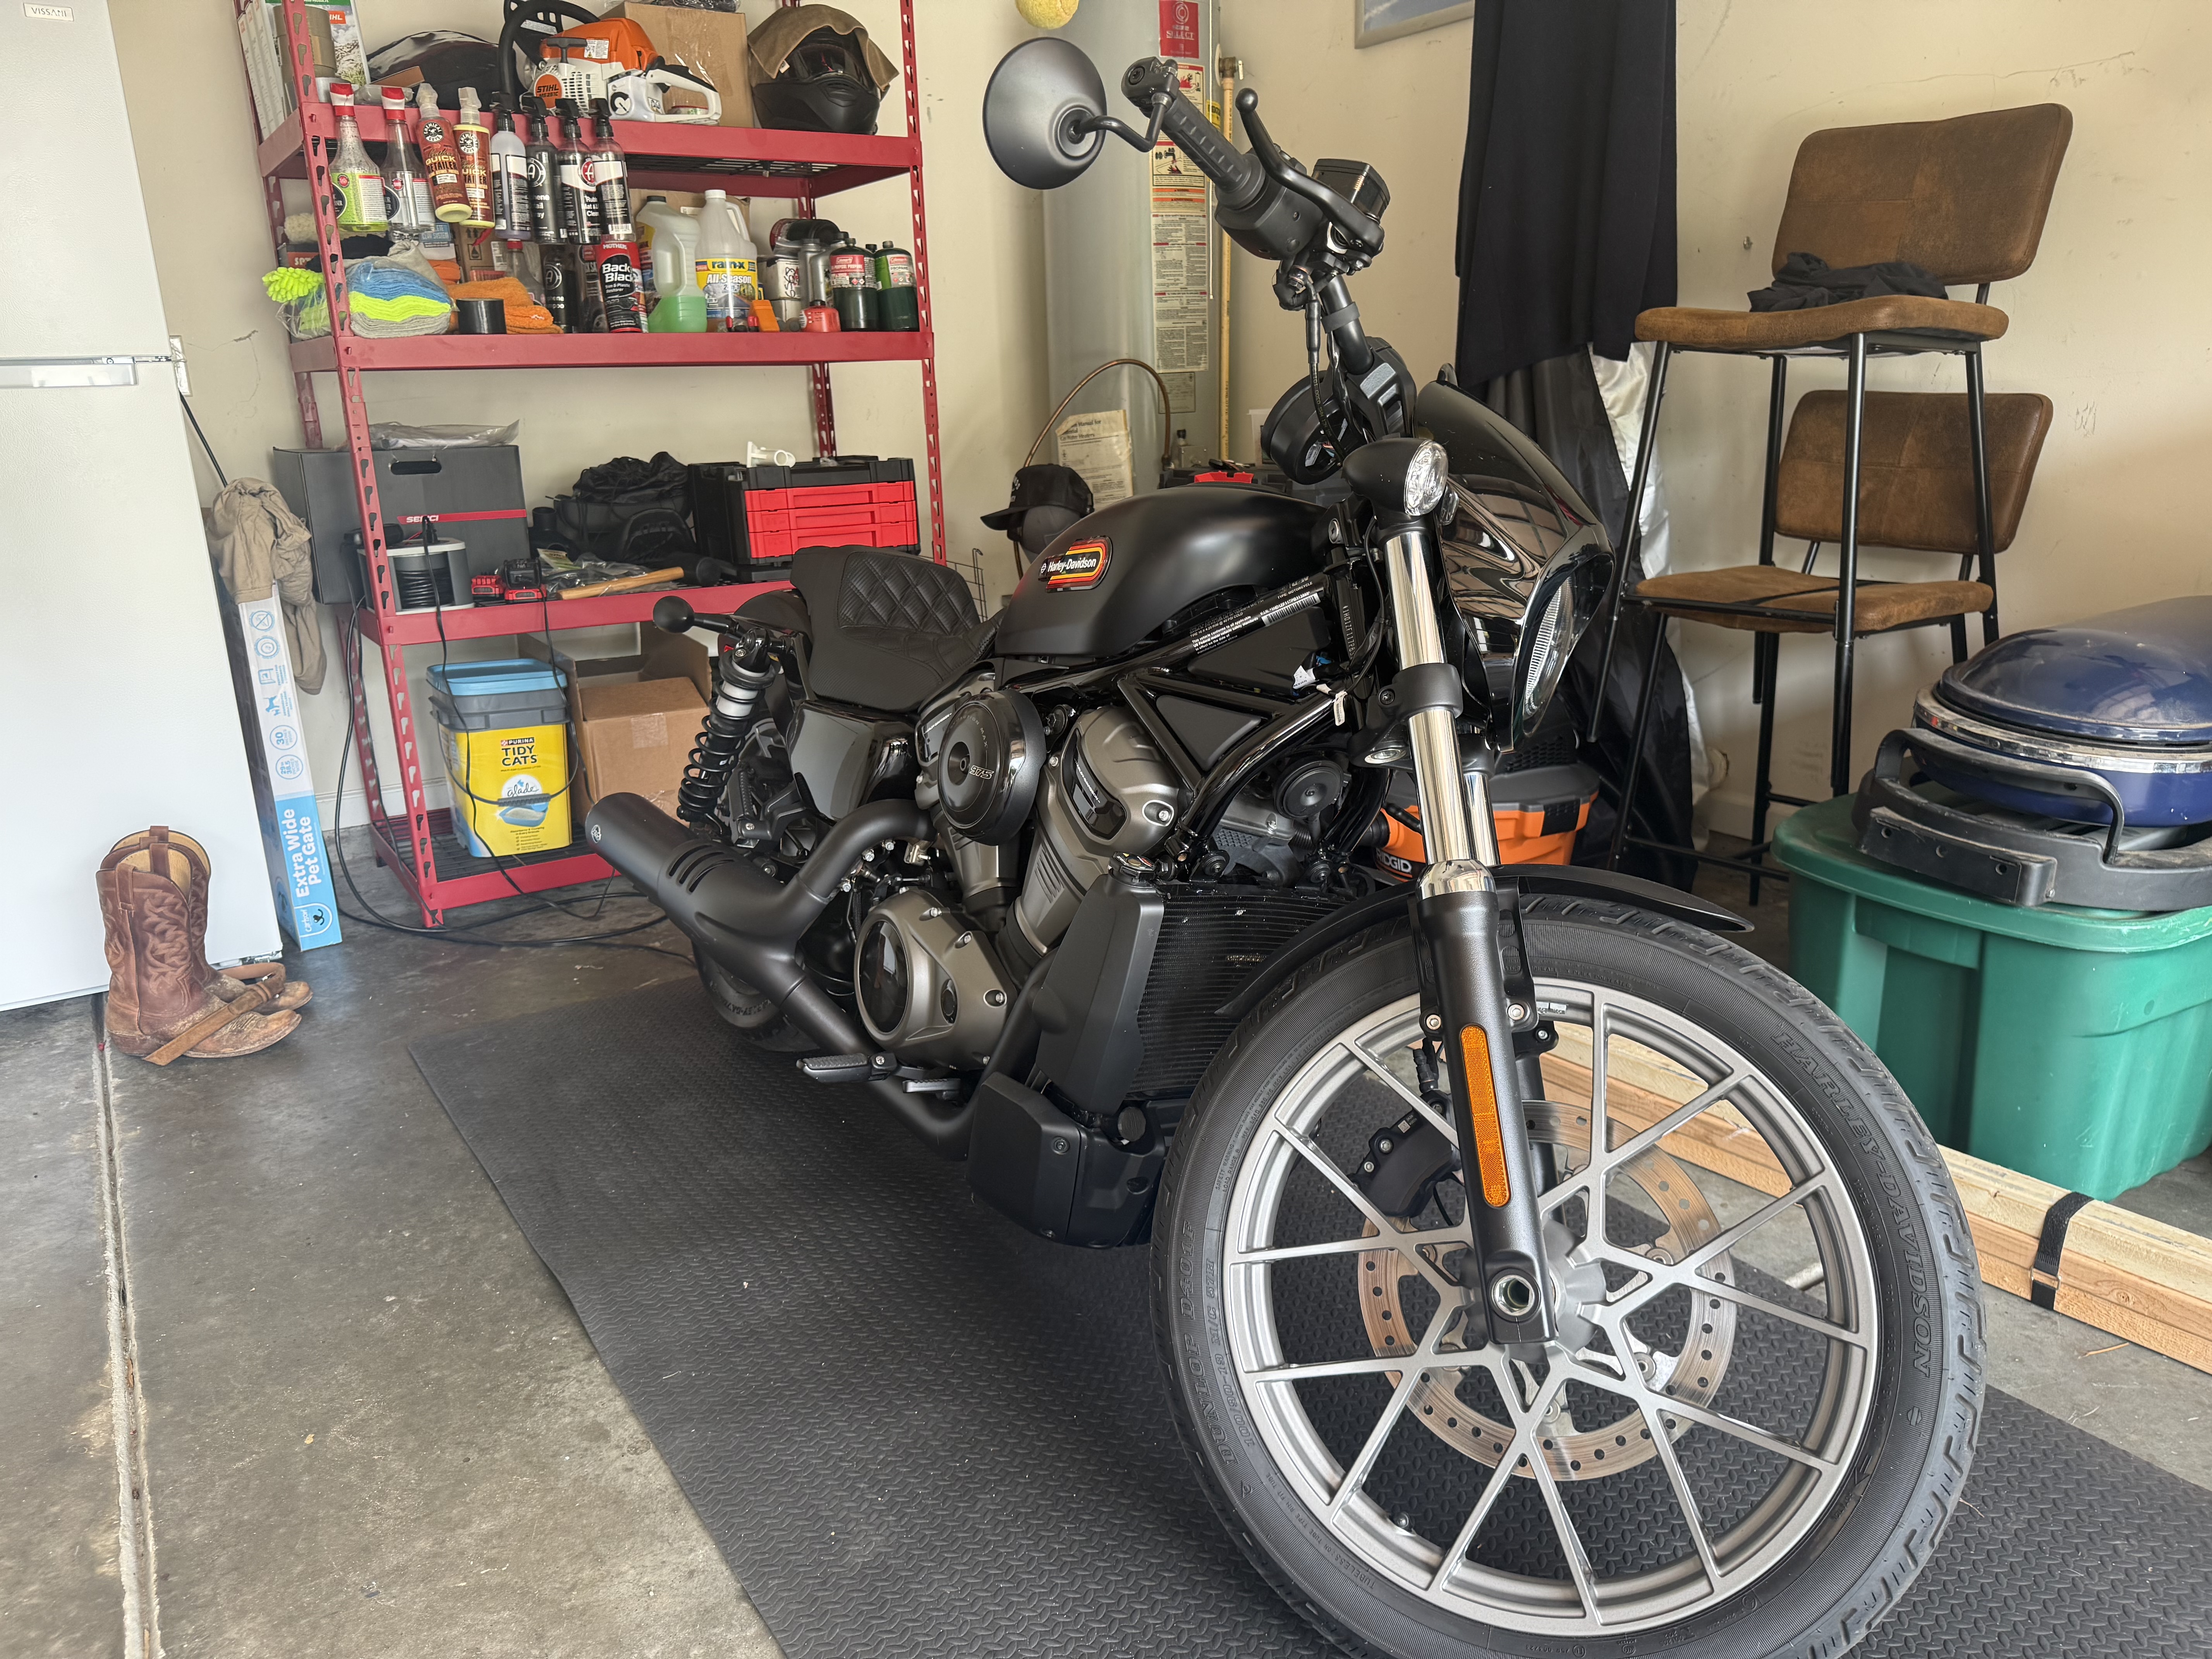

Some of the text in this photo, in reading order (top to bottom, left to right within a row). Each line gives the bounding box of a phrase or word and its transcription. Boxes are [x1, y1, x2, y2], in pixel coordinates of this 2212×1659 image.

[31, 7, 67, 17] VISSANI
[537, 84, 559, 93] STIHL
[424, 122, 442, 134] CHEMICAL
[426, 155, 457, 165] QUICK
[428, 161, 458, 173] DETAILER
[706, 273, 752, 284] All Season
[1048, 557, 1096, 572] Harley-Davidson
[1287, 581, 1313, 594] MOTORCYCLE
[1210, 626, 1226, 635] conforms
[1234, 615, 1252, 626] applicable
[1343, 610, 1356, 657] 1HD1ZF117PB3
[275, 732, 285, 745] 30
[501, 745, 534, 757] TIDY
[502, 755, 538, 766] CATS
[280, 766, 287, 774] 29
[969, 765, 994, 779] 975
[507, 782, 539, 797] glade
[282, 809, 309, 898] Extra Wide
[299, 816, 321, 885] Pet Gate
[1376, 851, 1412, 873] RIDGID
[300, 909, 312, 932] carlson
[1222, 1176, 1230, 1192] LOAD
[1227, 1154, 1238, 1175] RANGE
[1249, 1109, 1260, 1124] LOAD
[1258, 1097, 1267, 1108] 230
[1266, 1088, 1273, 1096] KG
[1215, 1168, 1225, 1190] SAFETY
[1772, 1031, 1932, 1377] HARLEY-DAVIDSON
[1180, 1220, 1196, 1320] D401F
[1204, 1261, 1255, 1447] 57H M/C 100/90-19
[1184, 1333, 1238, 1467] DUNLOP
[1265, 1472, 1278, 1489] TUBE
[1276, 1489, 1287, 1500] FIT
[1285, 1501, 1296, 1512] RIM
[1293, 1513, 1309, 1528] TYPE
[1308, 1528, 1323, 1543] TUBE
[1323, 1543, 1332, 1553] ON
